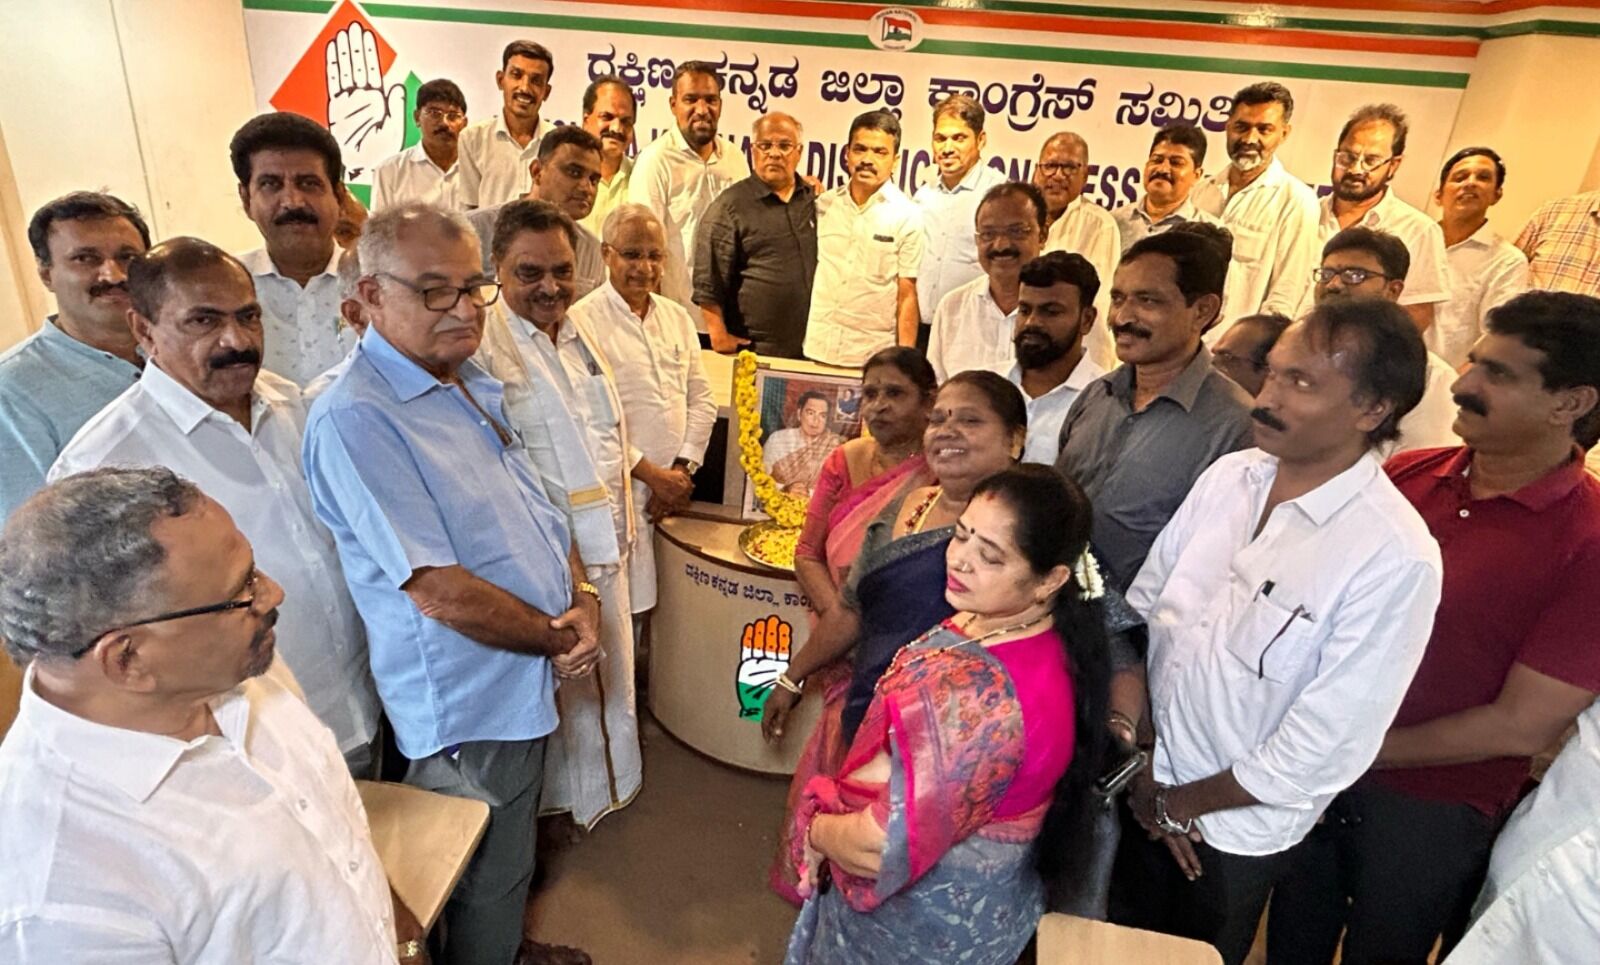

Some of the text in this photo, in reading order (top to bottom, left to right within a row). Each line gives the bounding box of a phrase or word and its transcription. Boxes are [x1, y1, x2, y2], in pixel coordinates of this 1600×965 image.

[928, 73, 1097, 132] ಕಾಂಗ್ರೆಸ್
[1116, 81, 1233, 132] ಸಮಿತಿ
[807, 141, 931, 198] DISIC
